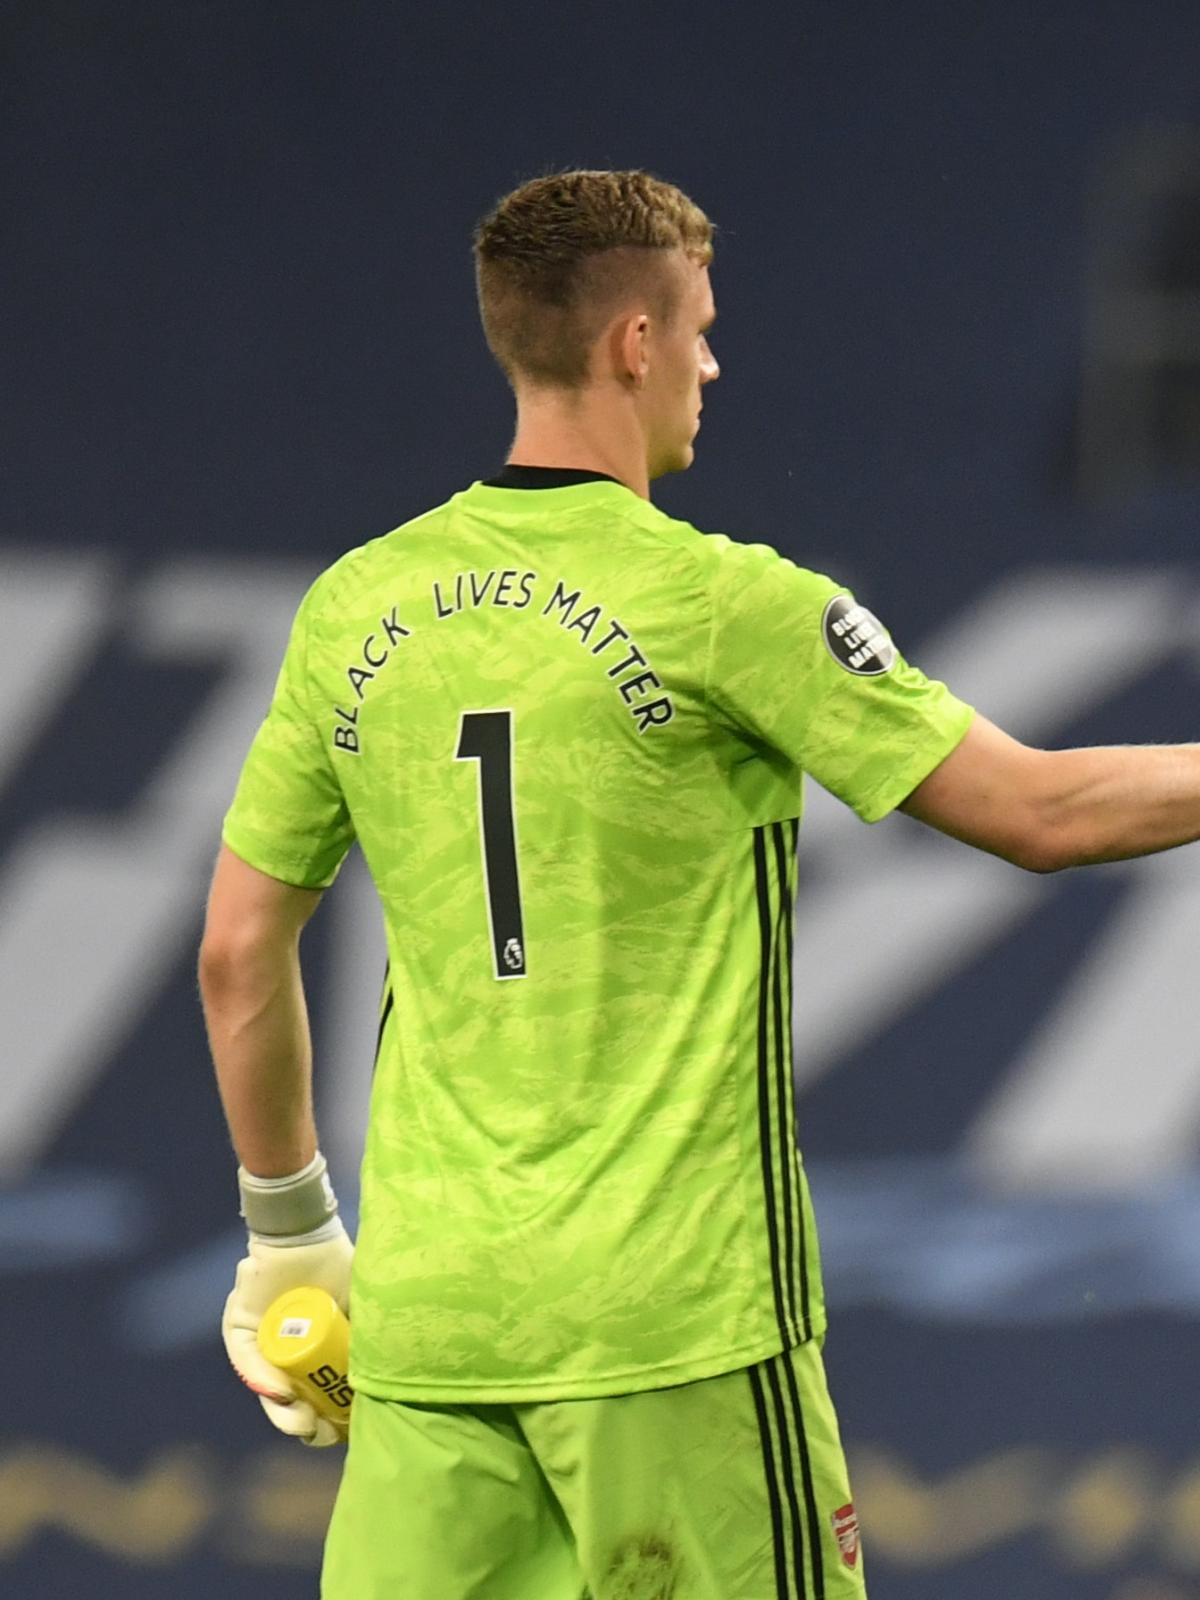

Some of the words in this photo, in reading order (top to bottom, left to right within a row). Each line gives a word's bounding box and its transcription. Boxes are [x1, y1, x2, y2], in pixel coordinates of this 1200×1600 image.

[832, 606, 868, 637] BLA
[844, 620, 879, 649] LIV
[334, 606, 410, 753] BLACK
[434, 571, 536, 618] LIVES
[543, 582, 674, 732] MATTER
[848, 634, 890, 669] MAT
[456, 710, 526, 978] 1
